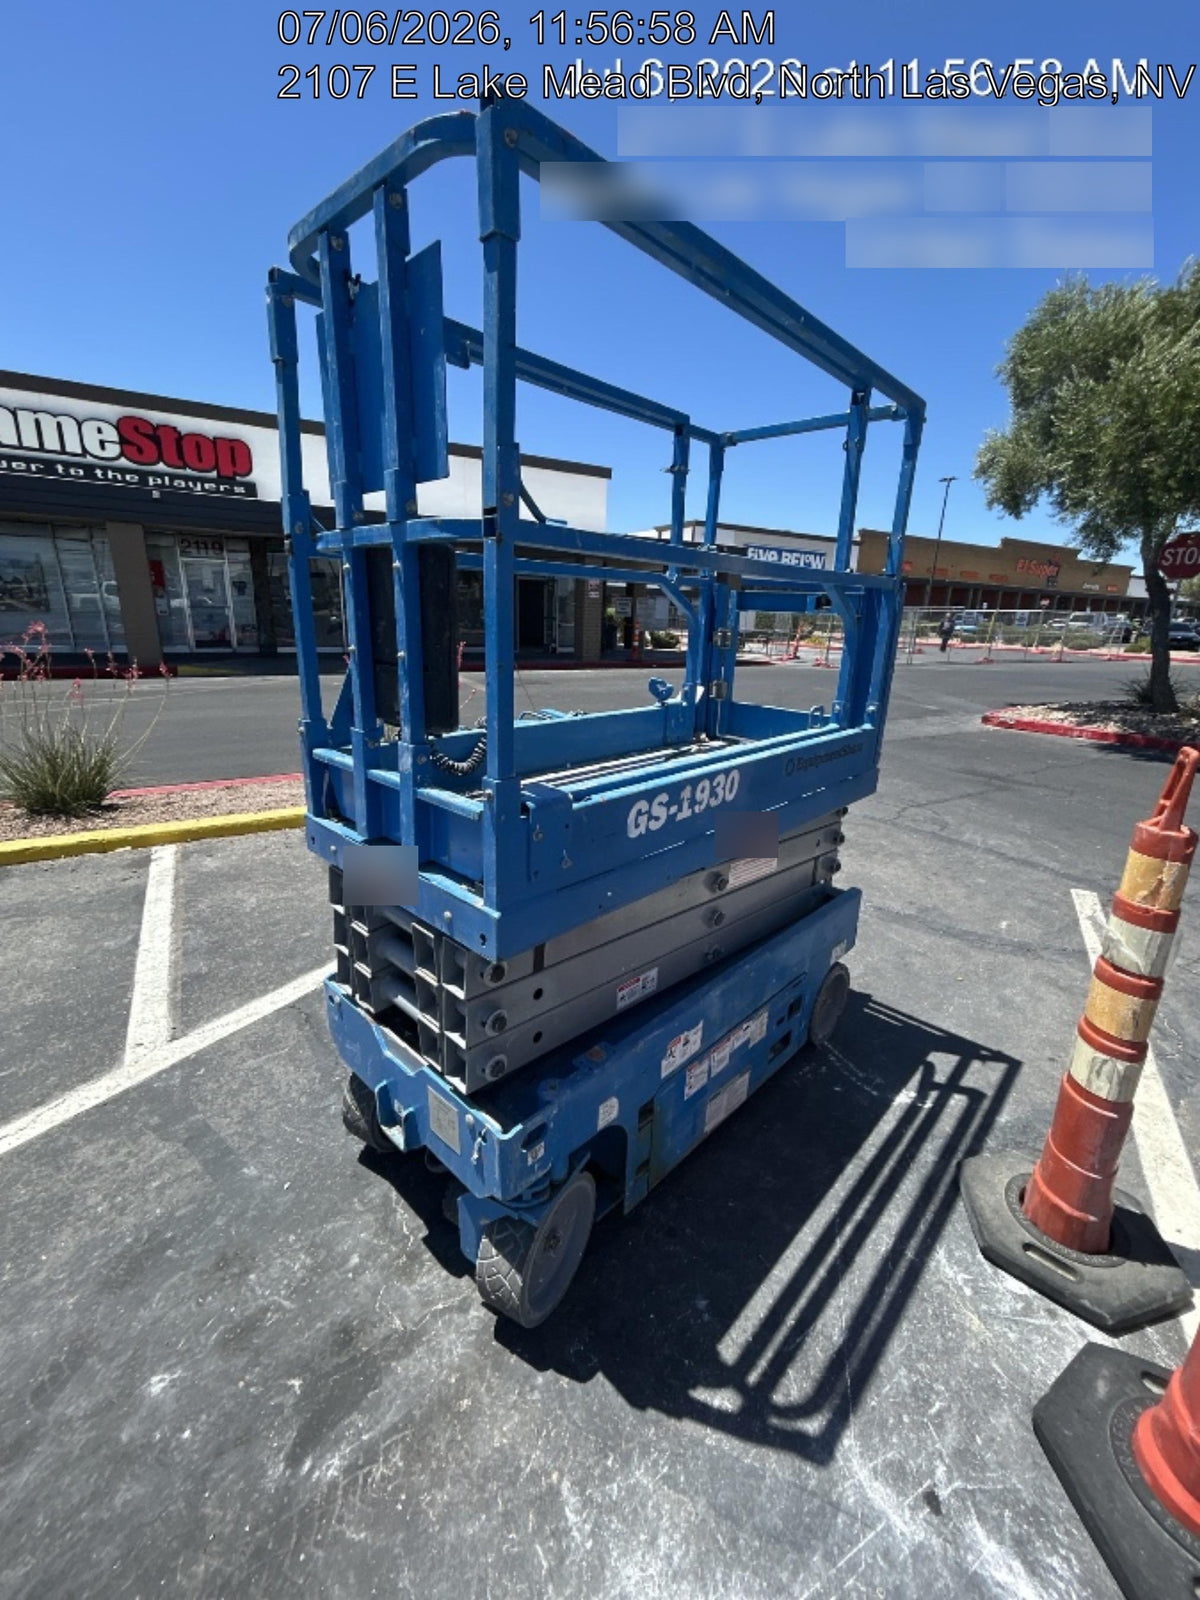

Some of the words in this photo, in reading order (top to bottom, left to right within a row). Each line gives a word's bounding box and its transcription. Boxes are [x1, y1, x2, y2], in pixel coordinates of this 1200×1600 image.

[56, 463, 84, 476] to
[94, 468, 139, 483] the
[148, 475, 247, 495] players
[1161, 547, 1200, 566] STO
[626, 769, 741, 839] GS-1930
